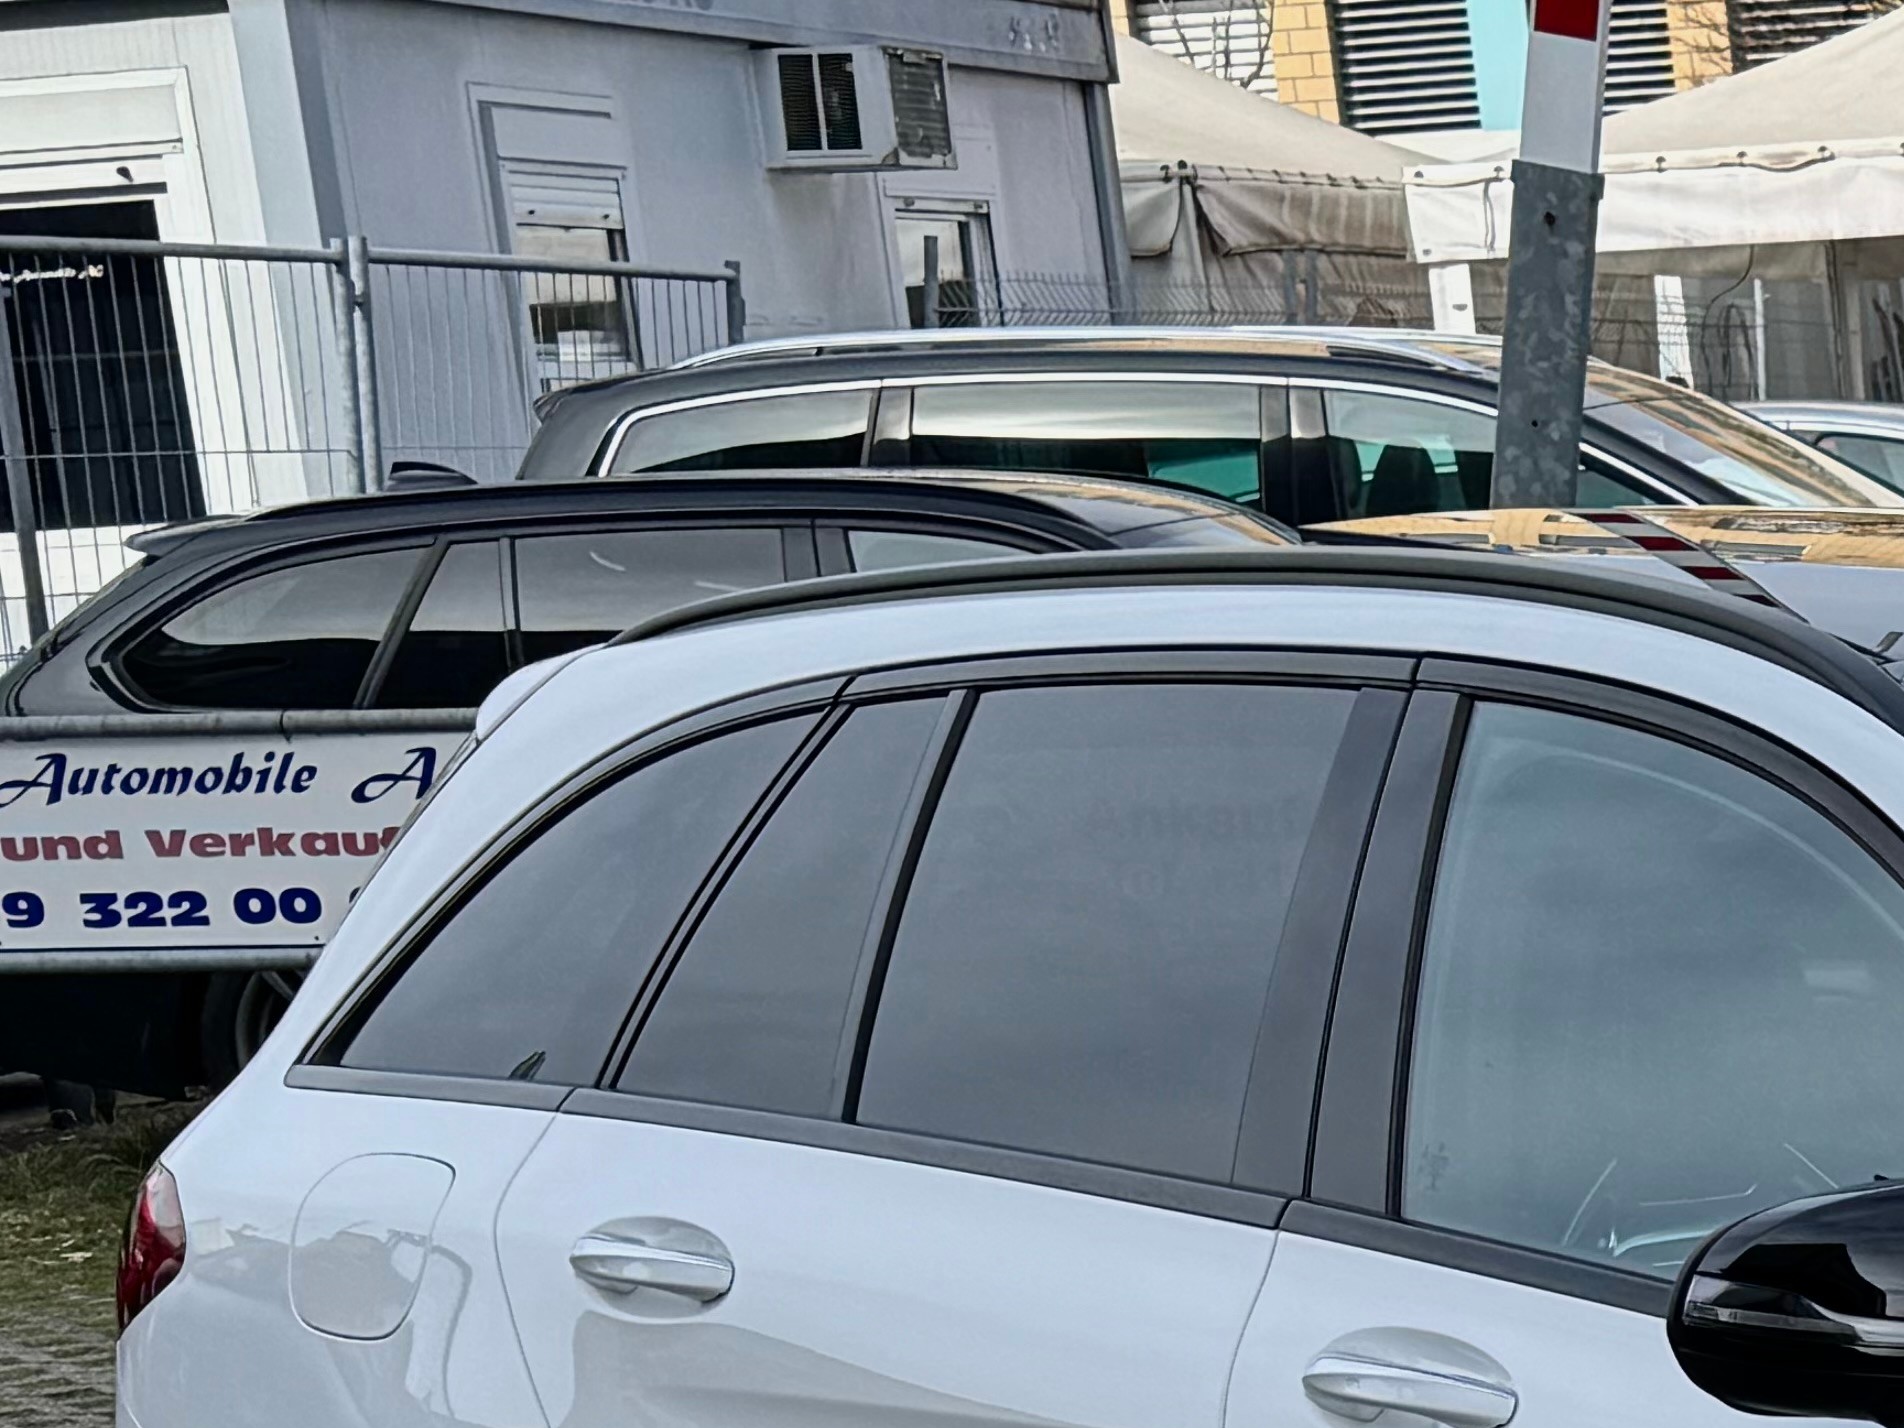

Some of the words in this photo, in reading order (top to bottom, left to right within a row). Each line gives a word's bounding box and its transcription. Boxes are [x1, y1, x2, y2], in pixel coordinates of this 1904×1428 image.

[0, 751, 318, 808] Automobile
[1, 829, 124, 861] und
[2, 891, 45, 928] 9
[79, 890, 211, 928] 322
[233, 887, 322, 925] 00
